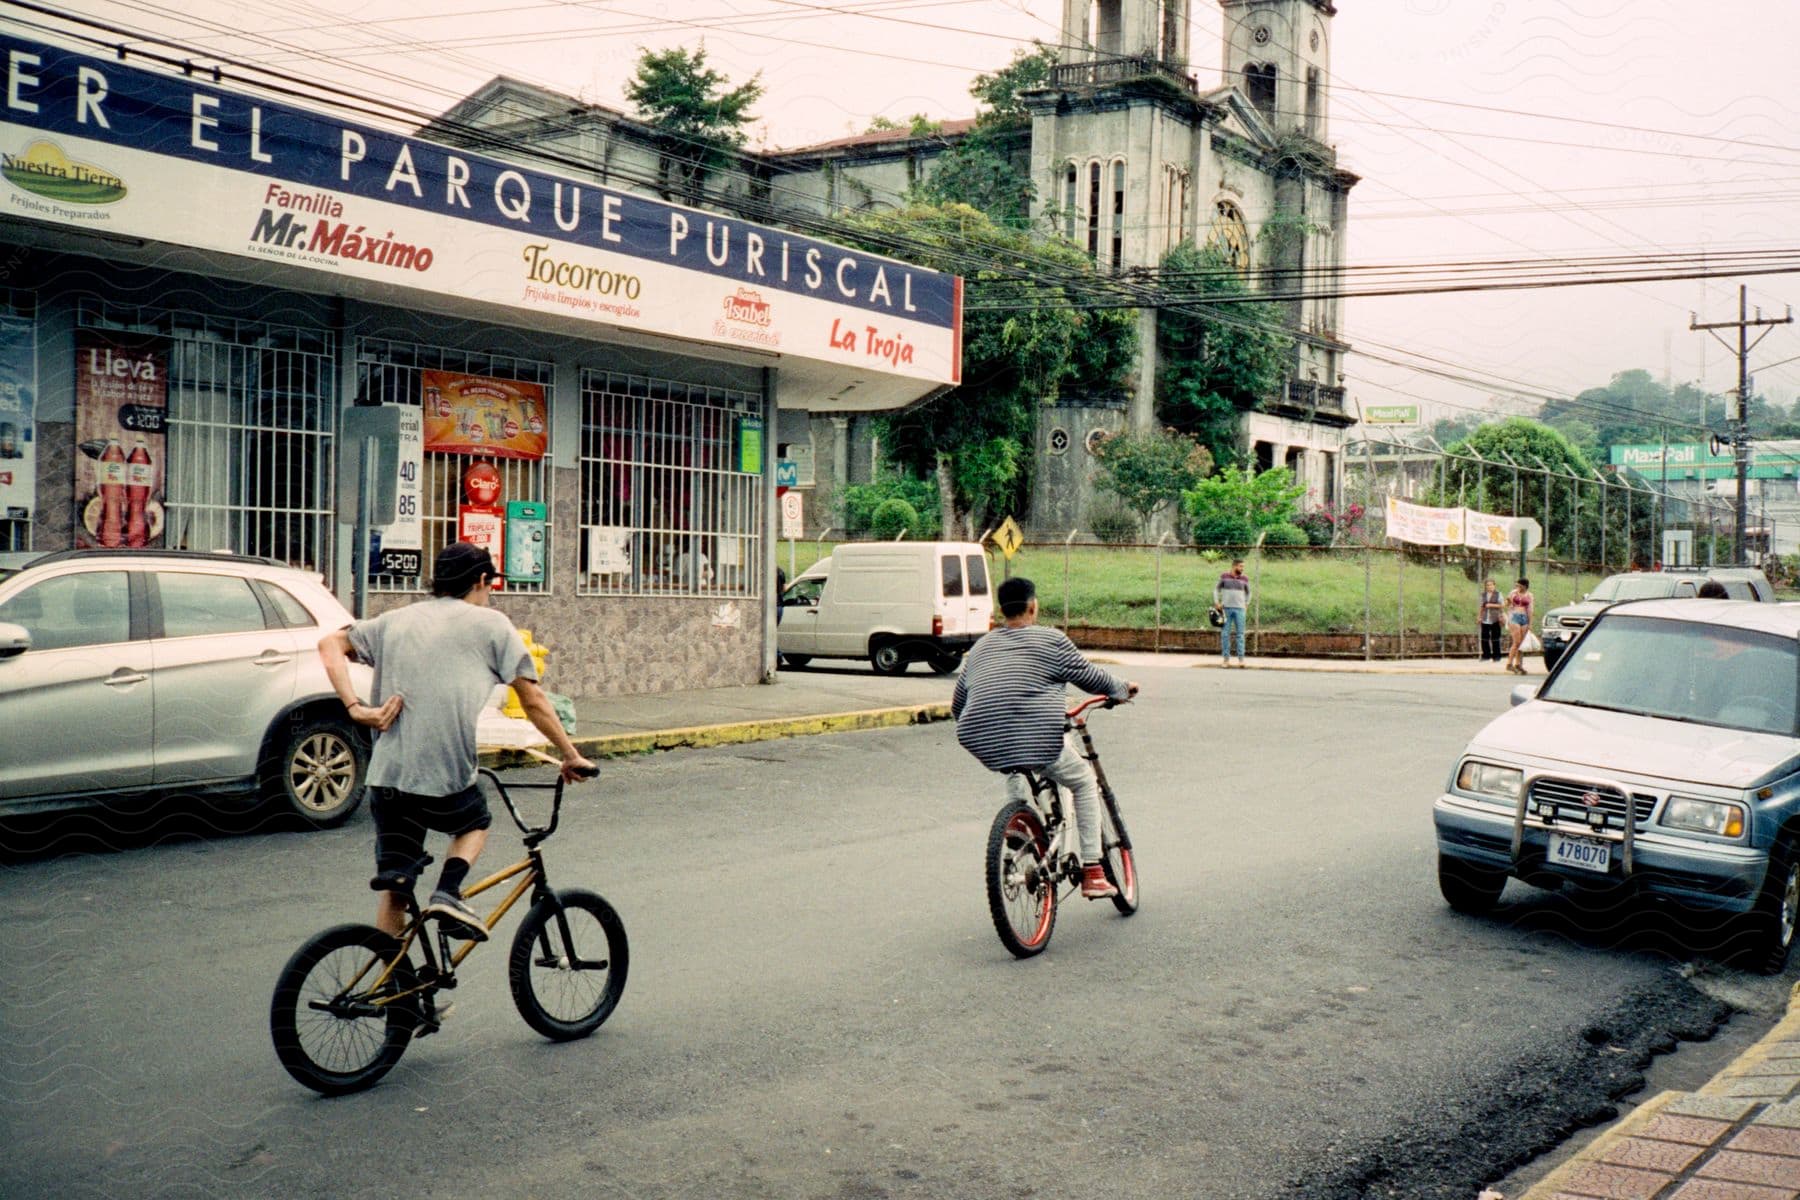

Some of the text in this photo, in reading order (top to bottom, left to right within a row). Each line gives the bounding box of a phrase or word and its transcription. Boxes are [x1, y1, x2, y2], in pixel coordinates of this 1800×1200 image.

[1, 152, 123, 190] Nuestra Tierra
[10, 194, 111, 220] Frijoles Preparados
[191, 93, 272, 164] EL
[341, 129, 623, 243] PARQUE
[669, 212, 917, 312] PURISCAL
[264, 183, 344, 218] Familia
[286, 252, 297, 260] DE
[308, 256, 339, 266] COCINA
[523, 244, 641, 300] Tocororo
[592, 301, 598, 312] y
[723, 296, 771, 327] Isabel
[829, 318, 914, 368] La Troja
[90, 348, 156, 380] Llevá
[470, 478, 497, 490] Claro
[398, 494, 416, 516] 85
[1557, 841, 1607, 865] 478070
